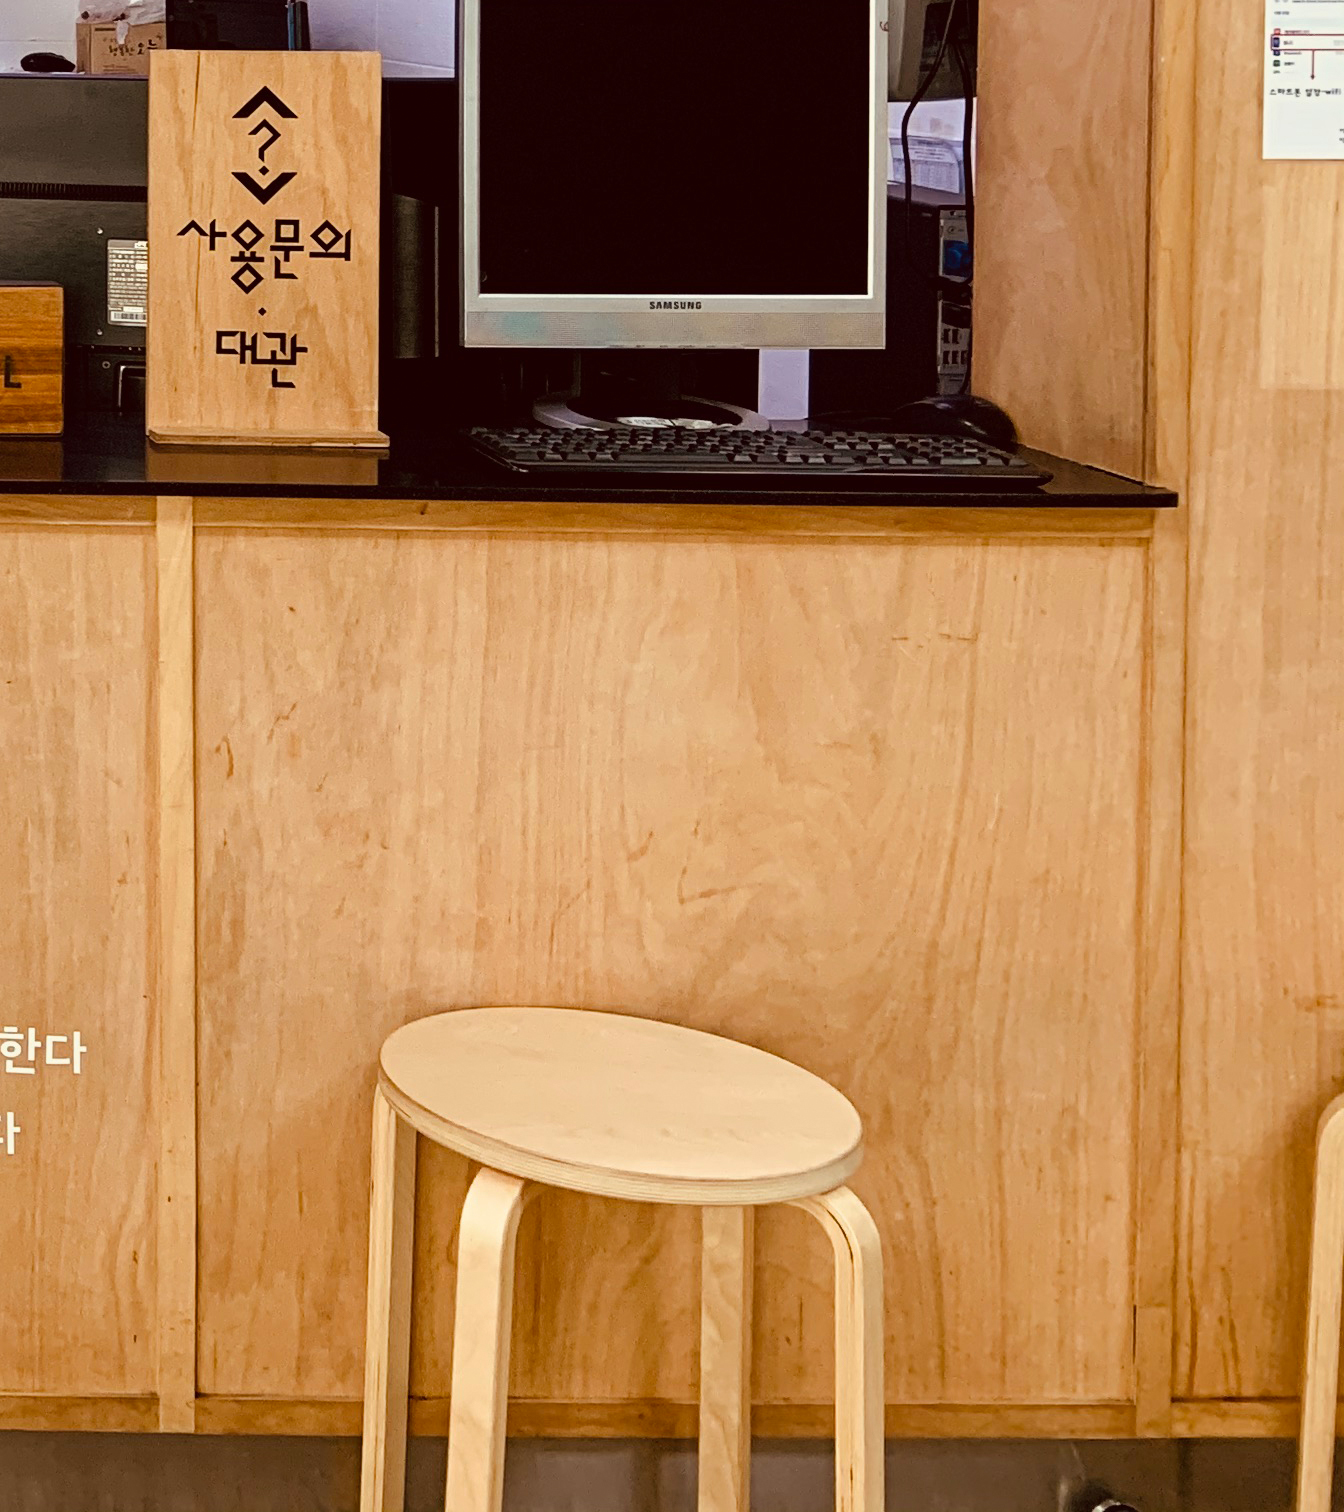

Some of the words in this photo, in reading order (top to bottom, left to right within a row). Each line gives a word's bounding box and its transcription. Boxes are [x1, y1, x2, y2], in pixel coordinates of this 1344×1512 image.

[176, 218, 352, 295] 사용문의
[649, 301, 702, 310] SAMSUNG
[215, 330, 309, 389] 대관
